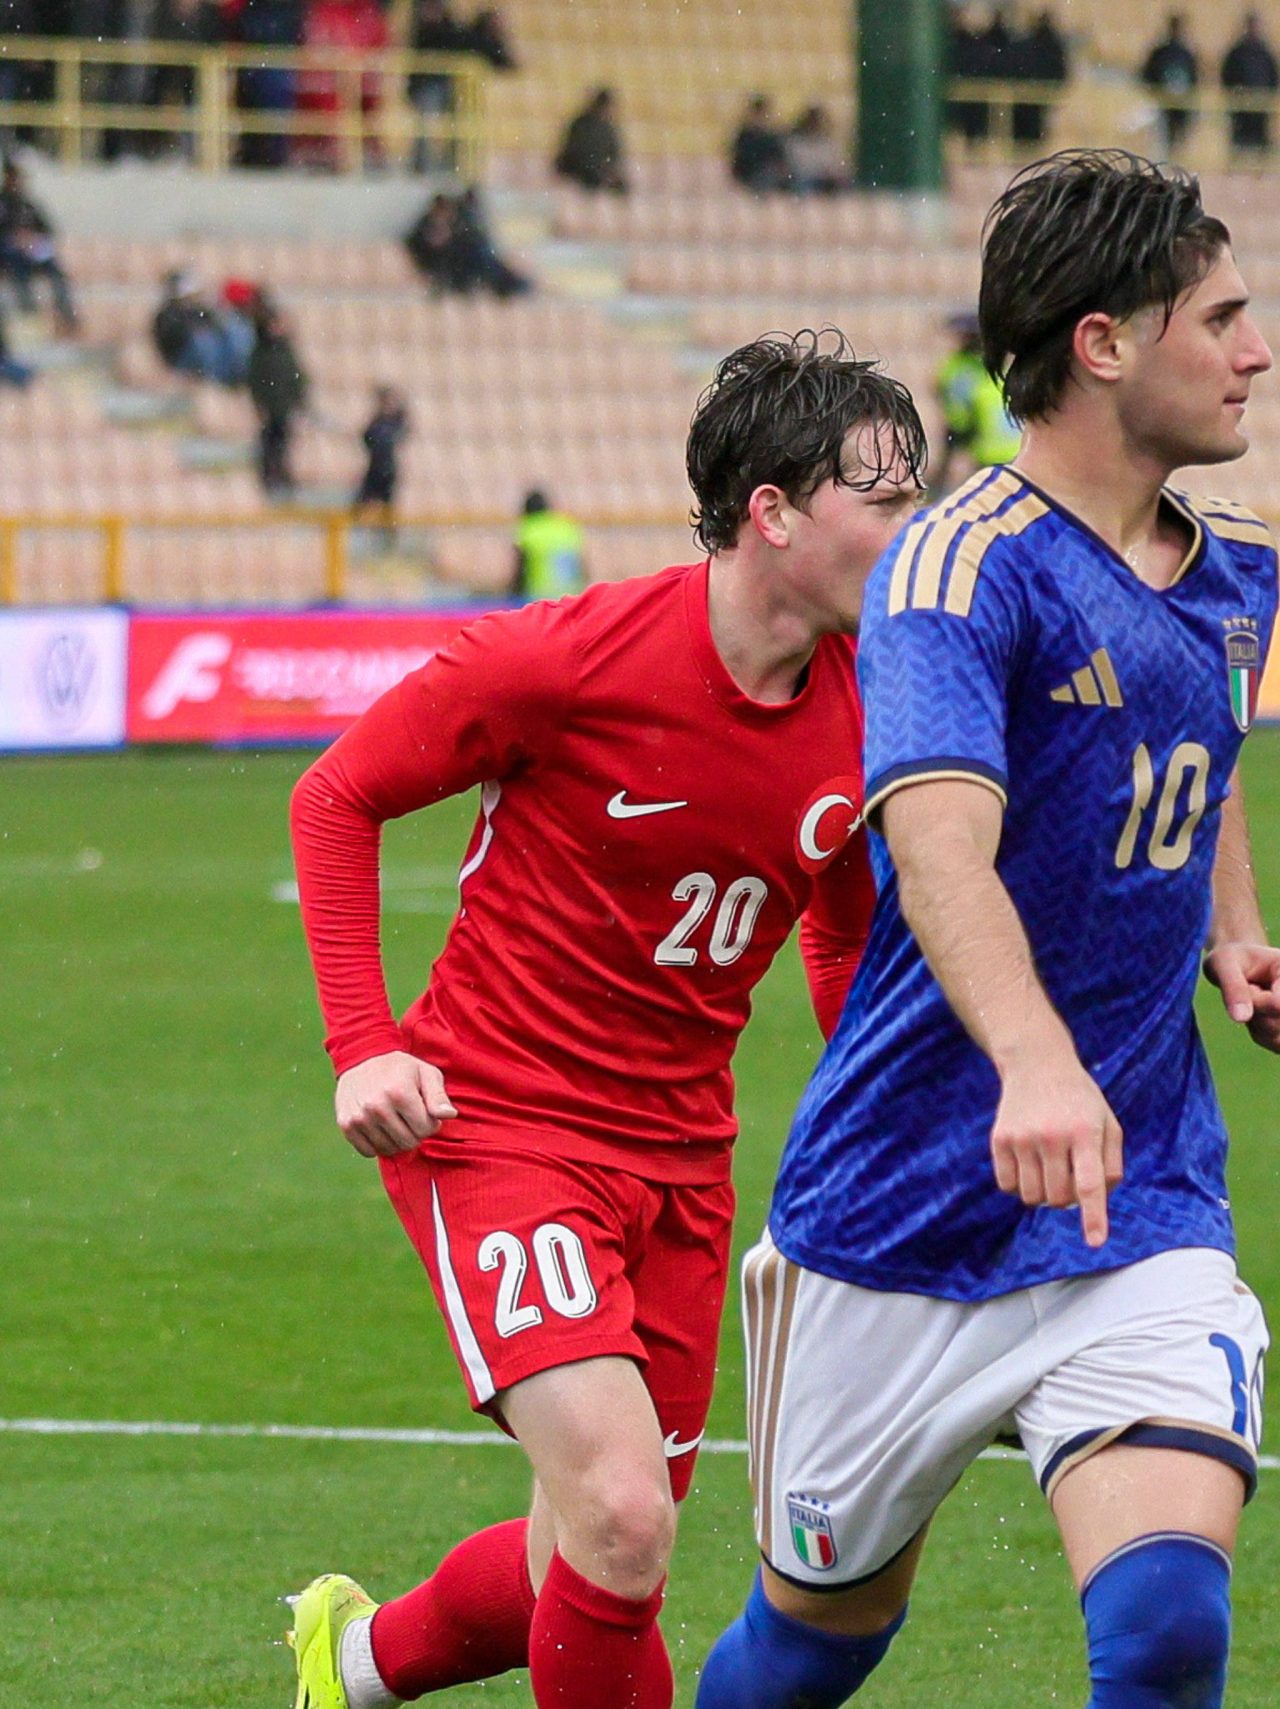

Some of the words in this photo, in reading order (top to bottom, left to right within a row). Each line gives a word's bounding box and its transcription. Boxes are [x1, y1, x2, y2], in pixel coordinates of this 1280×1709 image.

[1114, 742, 1211, 871] 10
[653, 871, 768, 966] 20
[477, 1222, 599, 1339] 20
[790, 1506, 827, 1529] ITALIA
